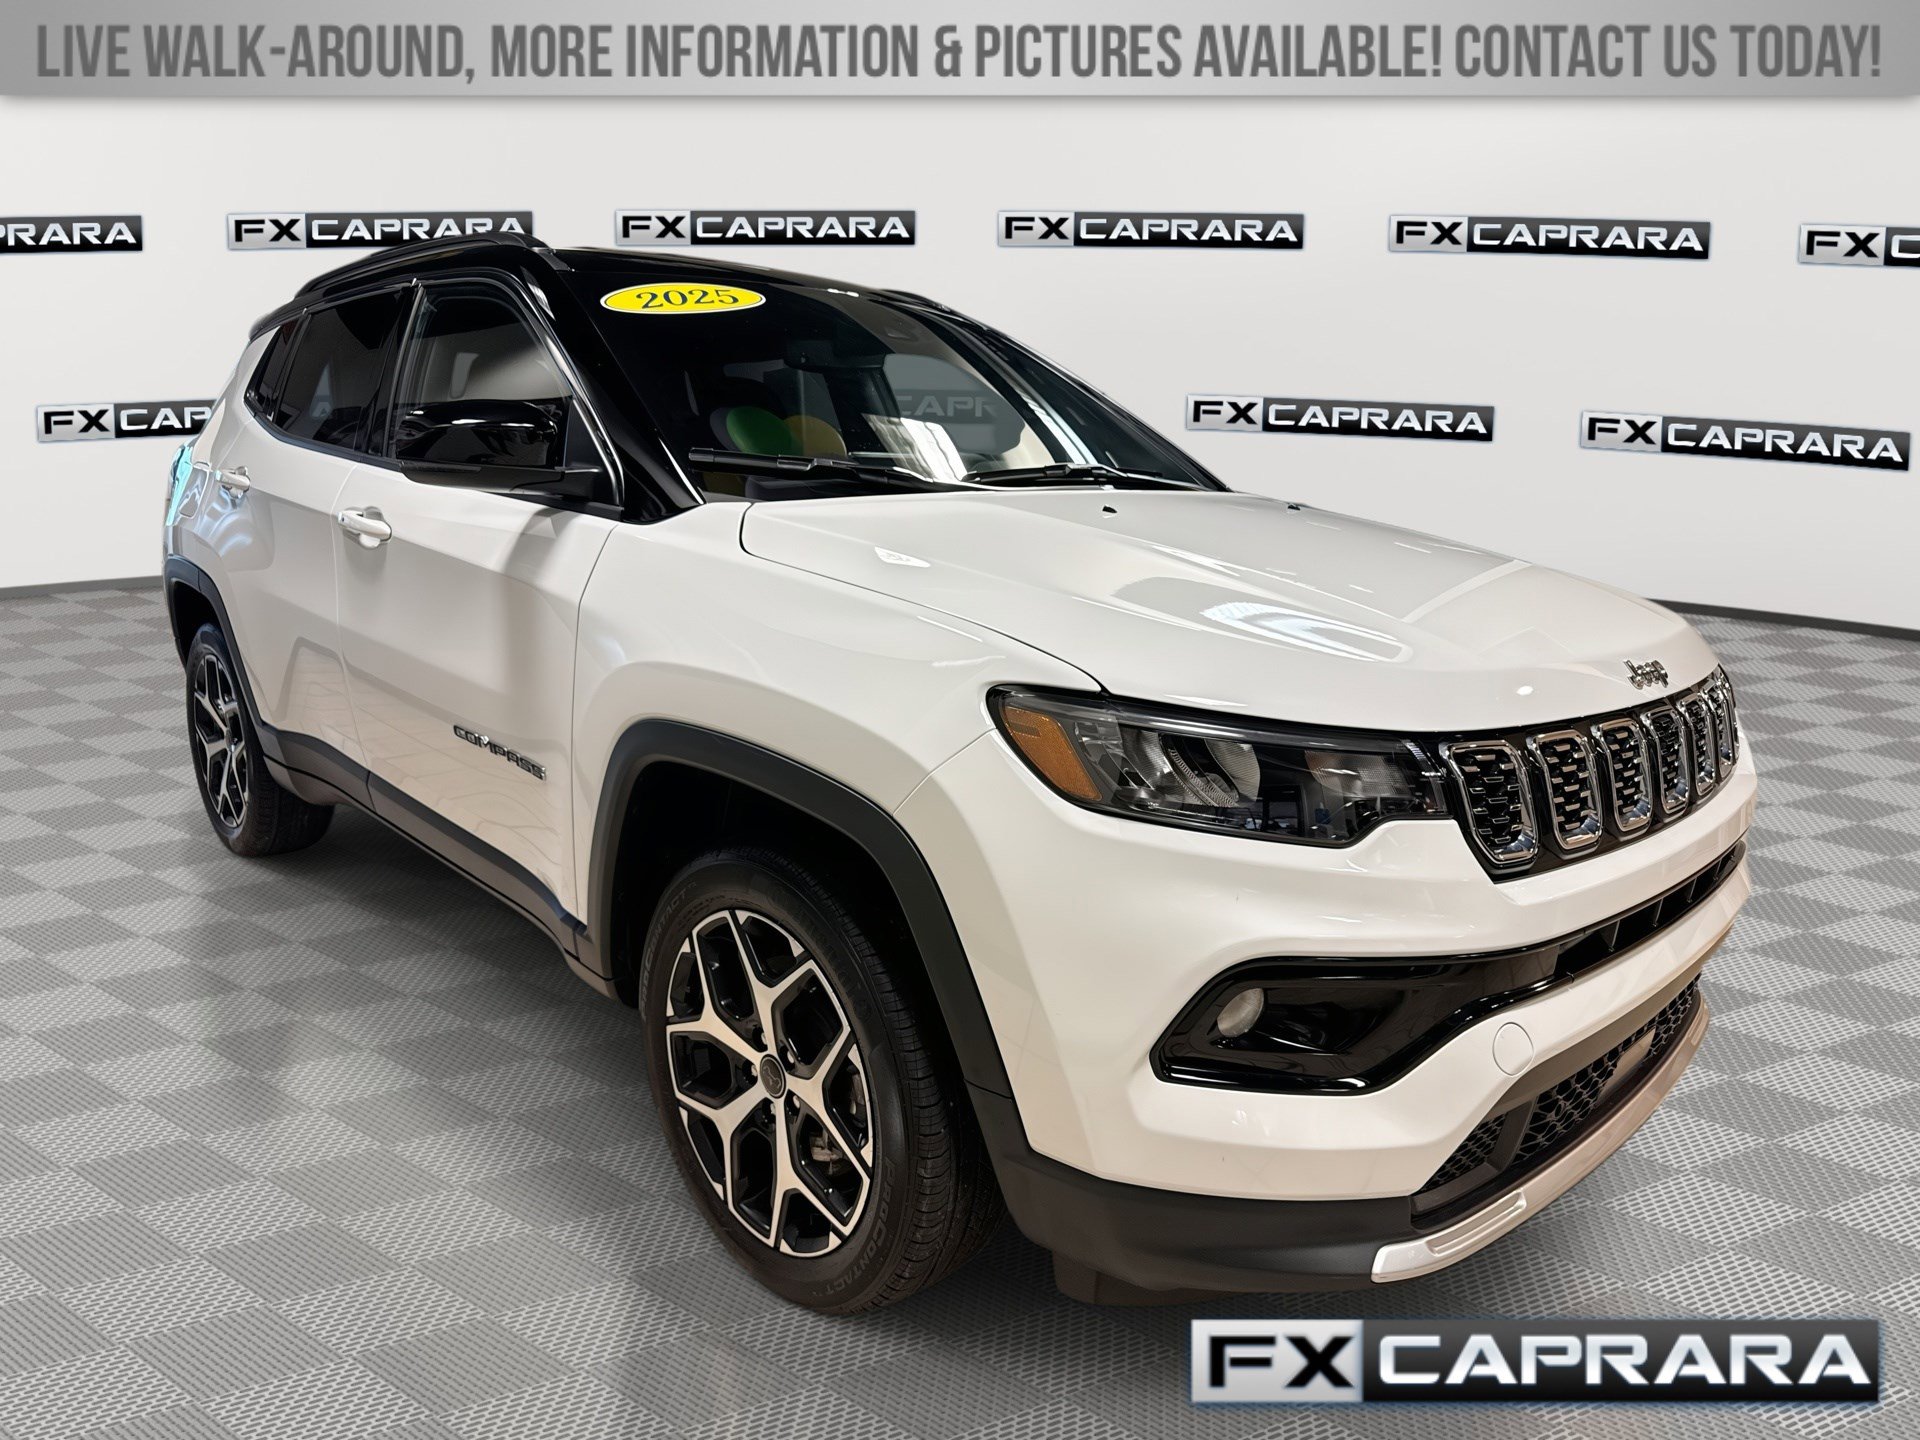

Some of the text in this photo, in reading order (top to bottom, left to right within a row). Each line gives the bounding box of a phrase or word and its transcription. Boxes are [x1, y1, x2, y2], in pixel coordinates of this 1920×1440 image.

[235, 219, 300, 242] FX
[622, 215, 910, 238] FX CAPRARA
[1004, 216, 1298, 242] FX CAPRARA
[1395, 220, 1704, 252] FX CAPRARA
[1805, 230, 1880, 258] FX
[635, 288, 740, 310] 2025
[43, 409, 110, 435] FX
[1192, 400, 1488, 435] FX CAPRARA
[1587, 417, 1904, 463] FX CAPRARA
[1622, 659, 1669, 690] Jeep
[453, 725, 546, 780] COMPASS
